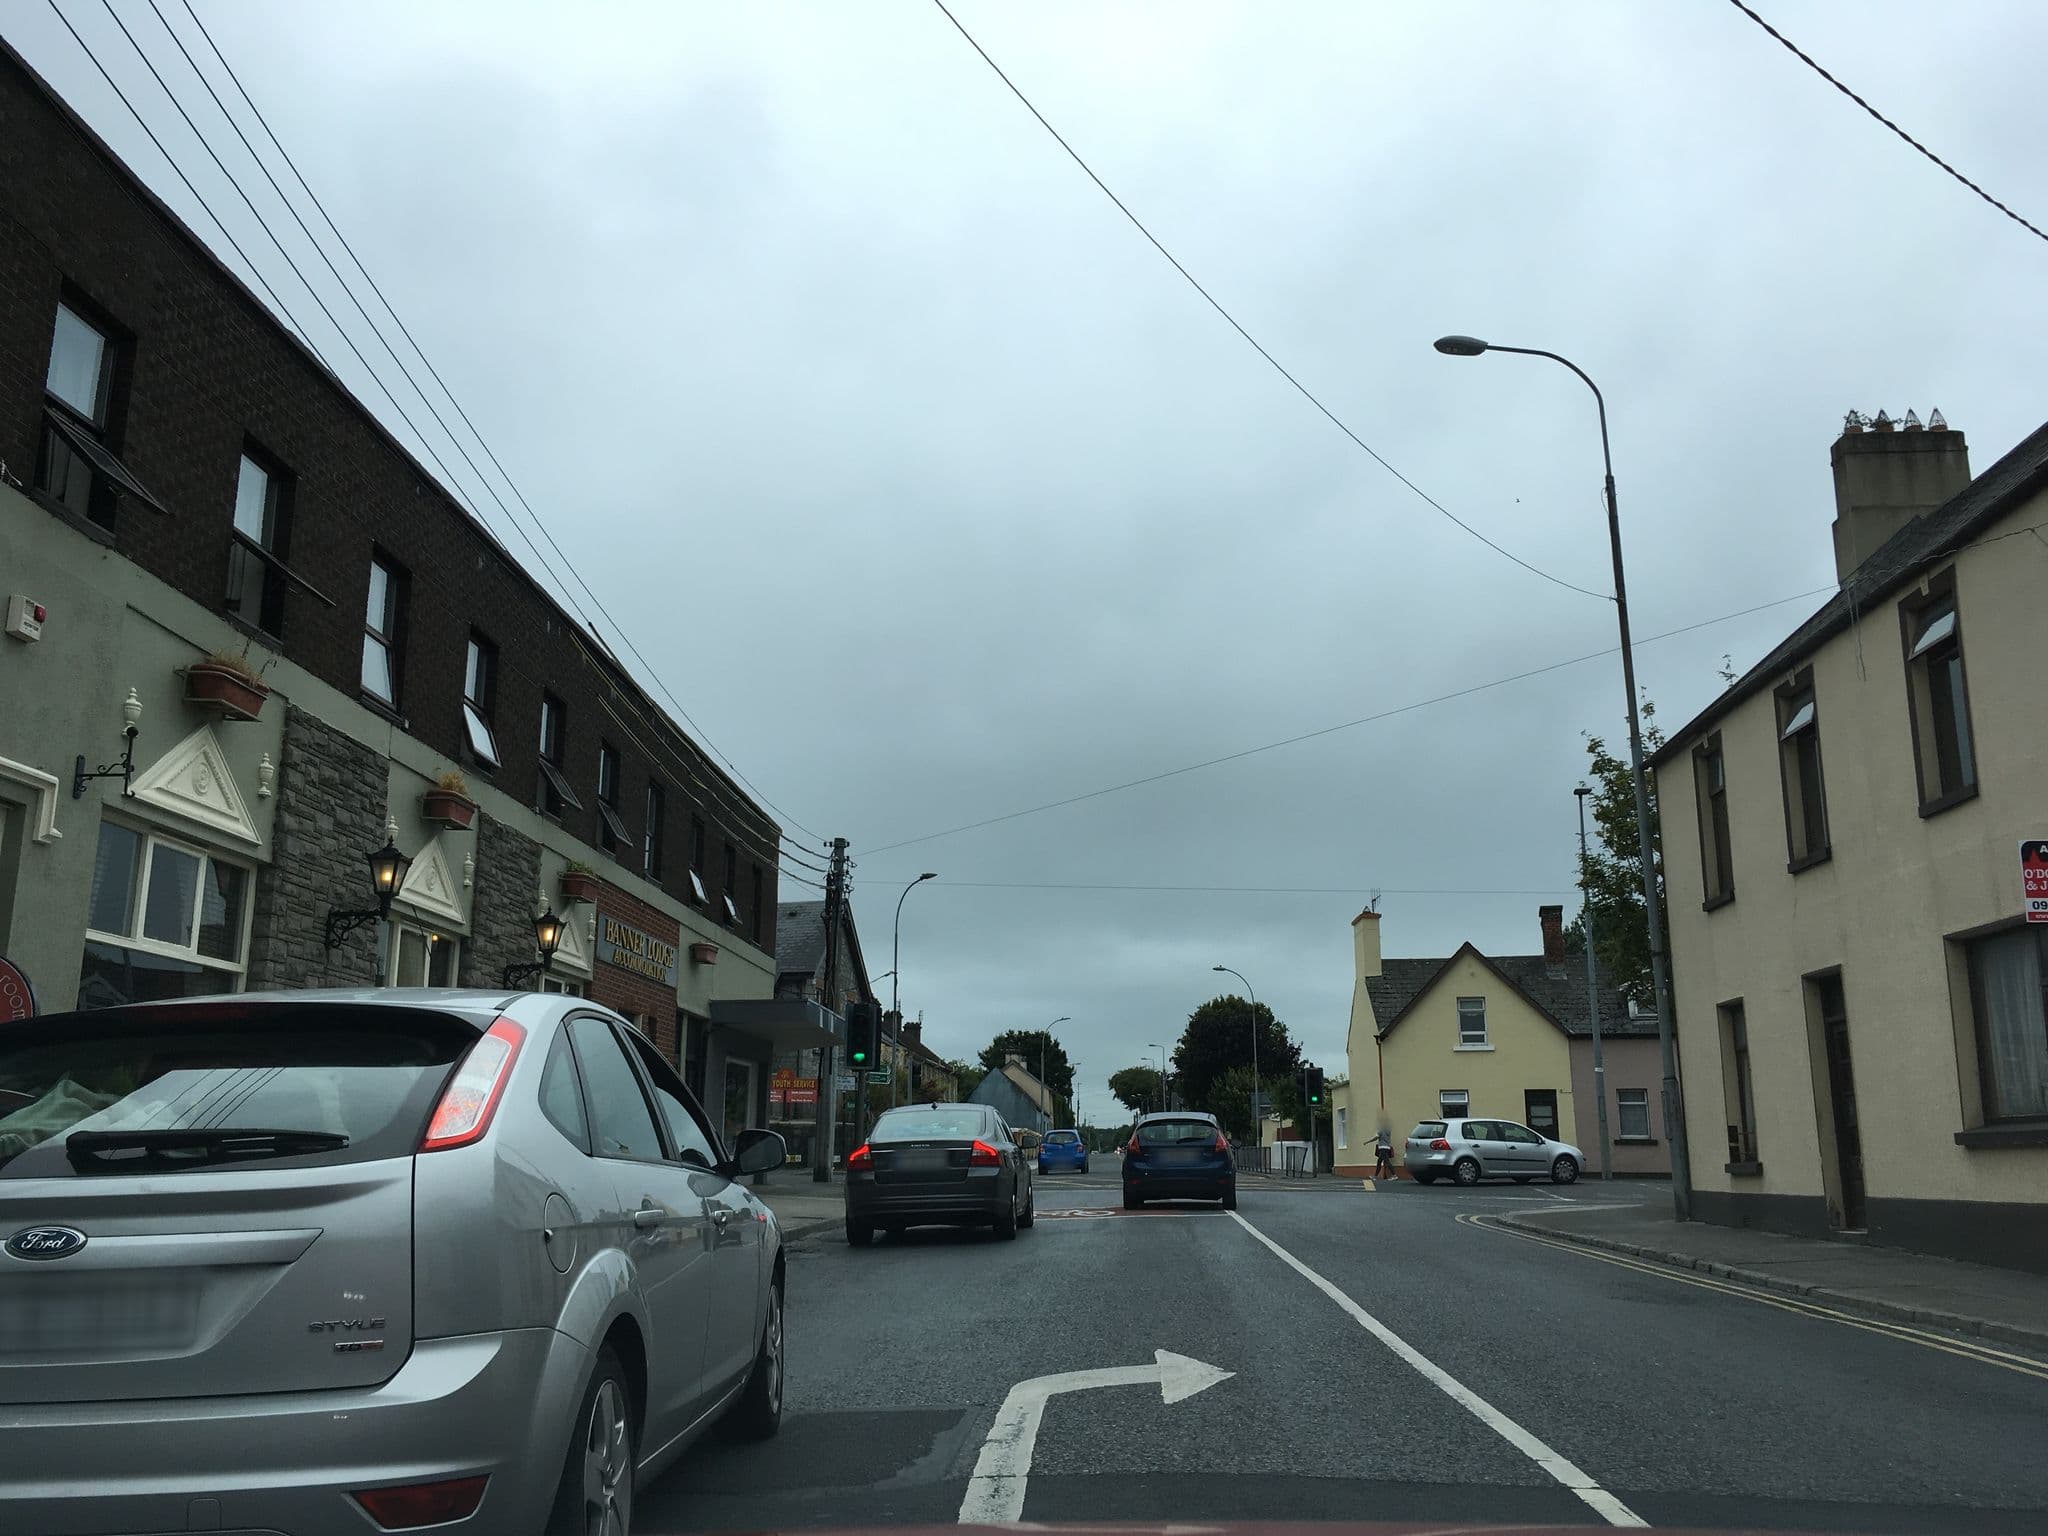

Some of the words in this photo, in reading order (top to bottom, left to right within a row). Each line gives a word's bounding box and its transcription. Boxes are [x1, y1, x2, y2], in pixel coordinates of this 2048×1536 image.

[606, 919, 644, 956] BANNER
[647, 938, 673, 968] LODGE
[613, 948, 667, 982] ACCOMMODATION
[772, 1079, 791, 1088] YOUTH
[793, 1080, 815, 1089] SERVICE
[20, 1230, 68, 1250] Ford
[308, 1317, 386, 1332] STYLE
